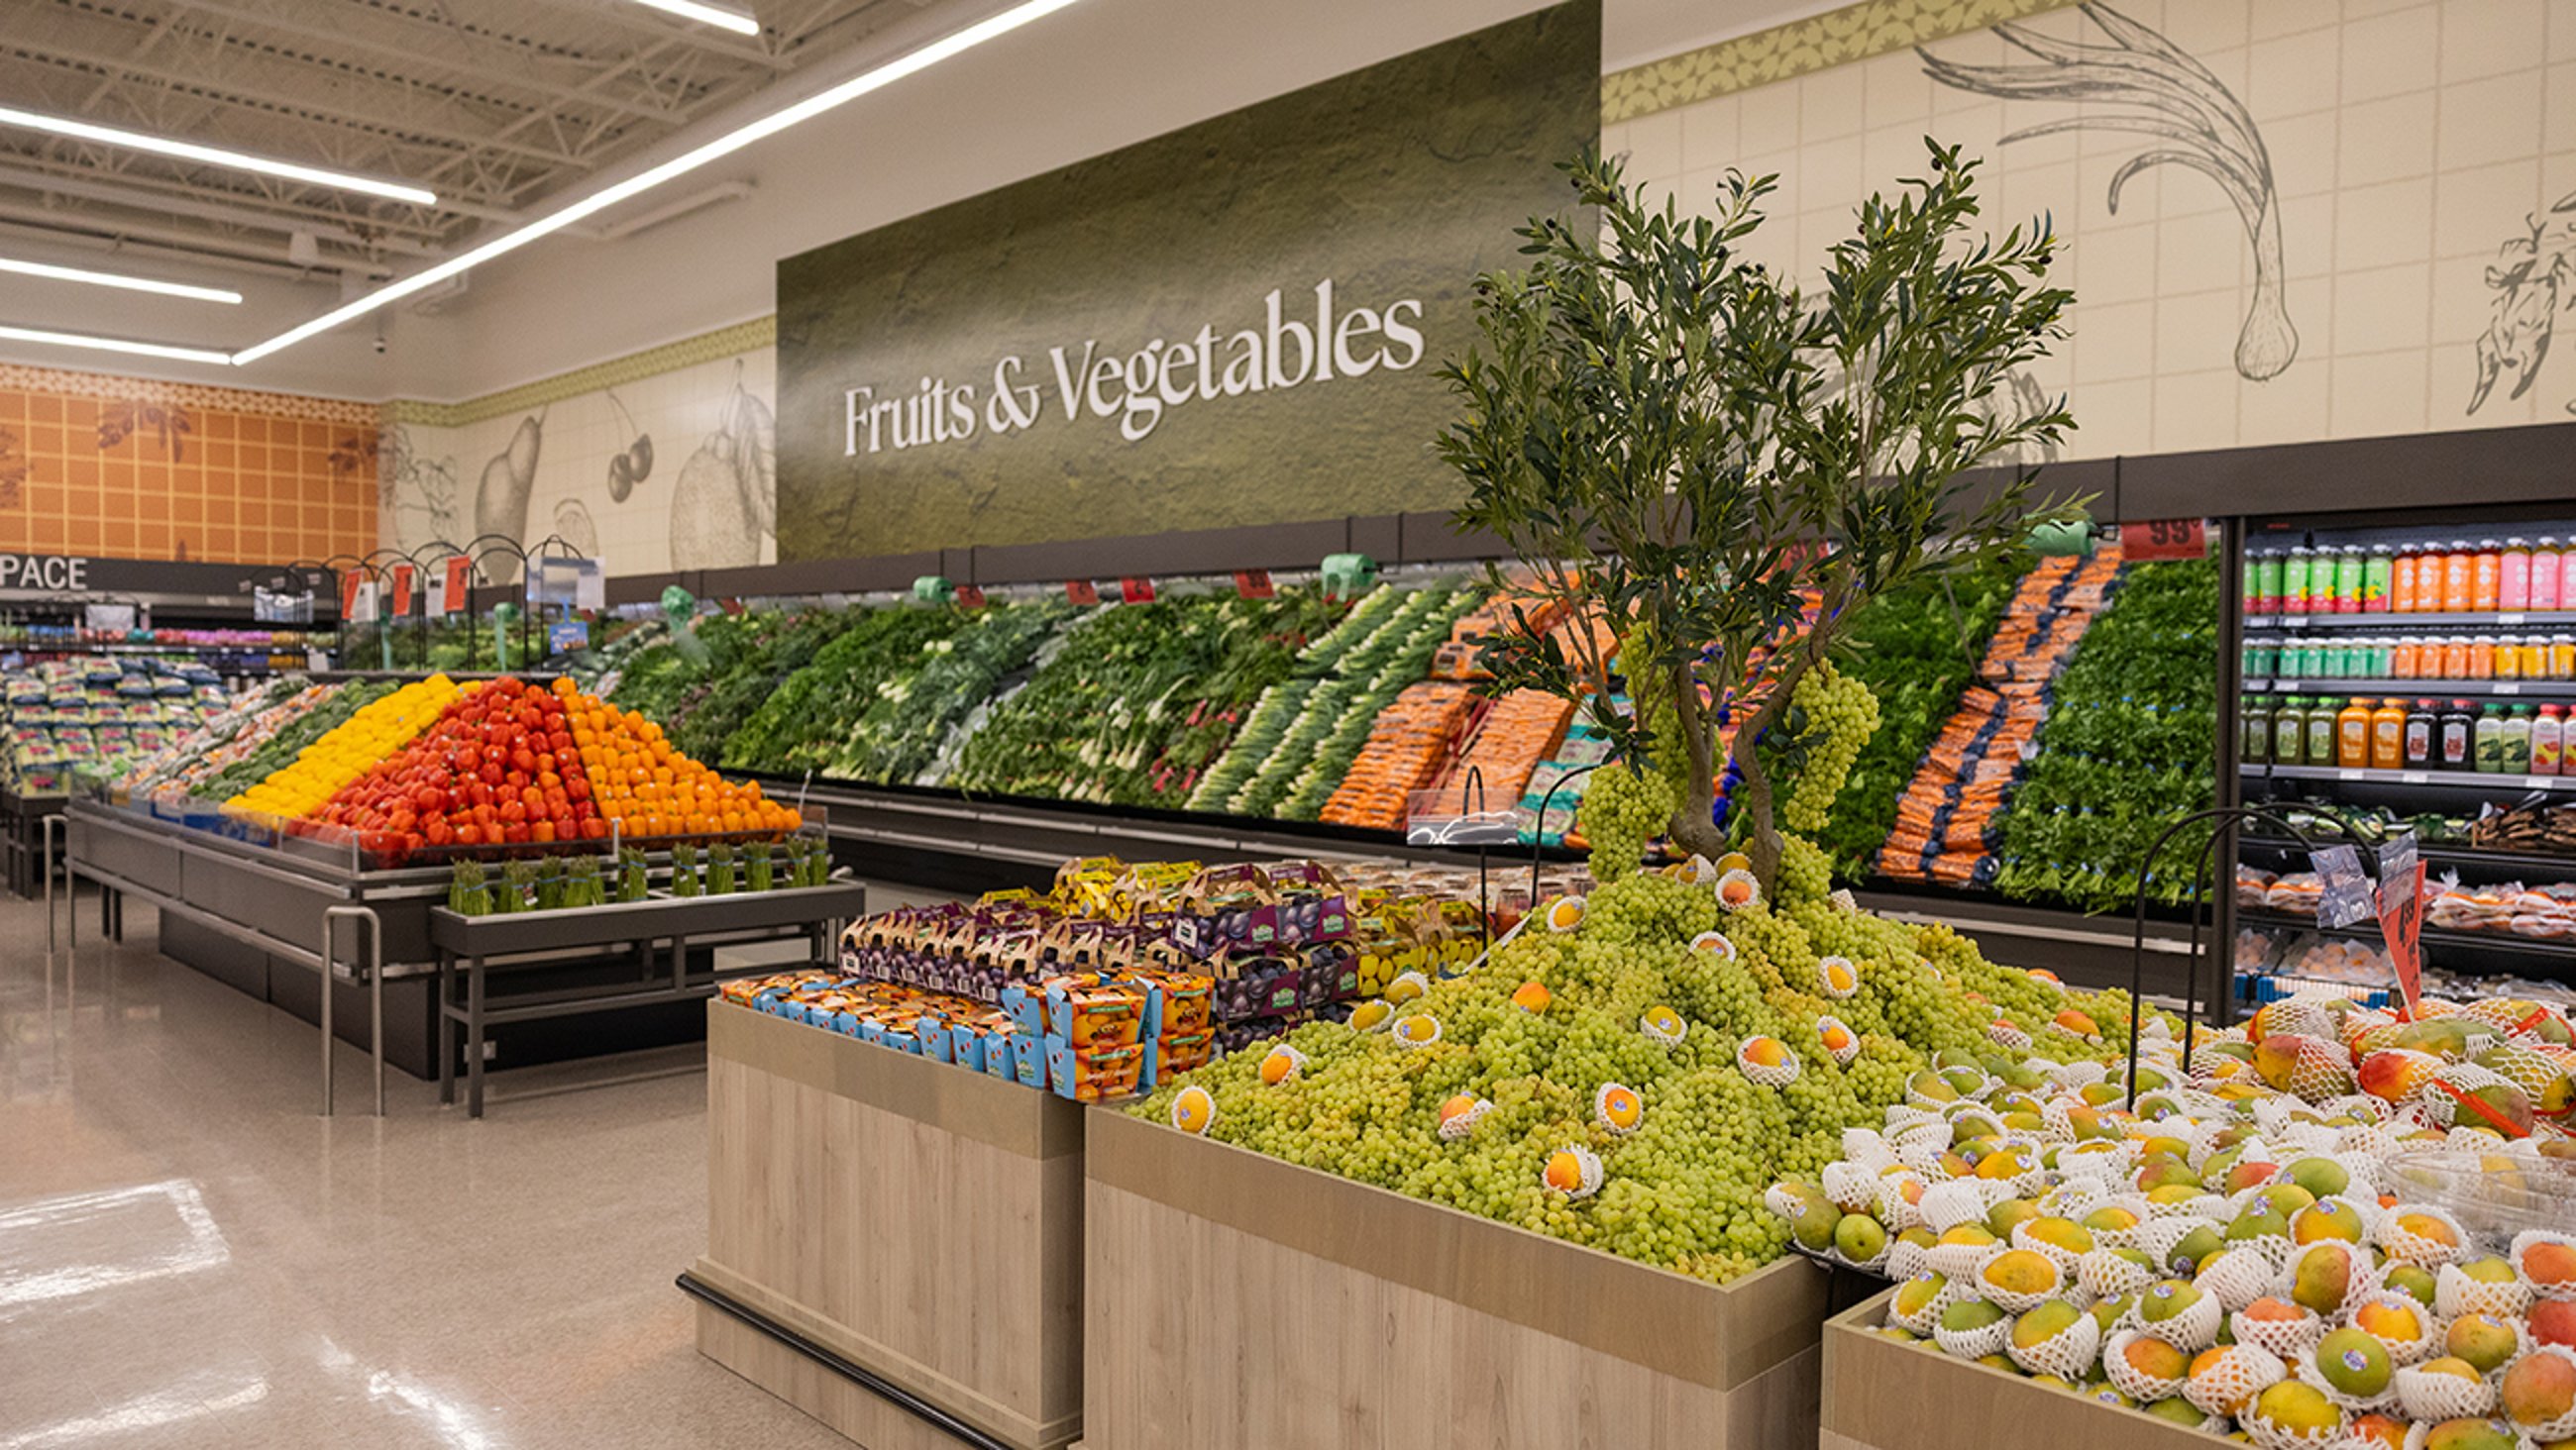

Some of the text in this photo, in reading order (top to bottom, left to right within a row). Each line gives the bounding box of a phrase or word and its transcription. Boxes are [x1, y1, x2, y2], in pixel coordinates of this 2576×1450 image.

[844, 277, 1424, 456] Fruits & Vegetables
[0, 555, 86, 589] PACE
